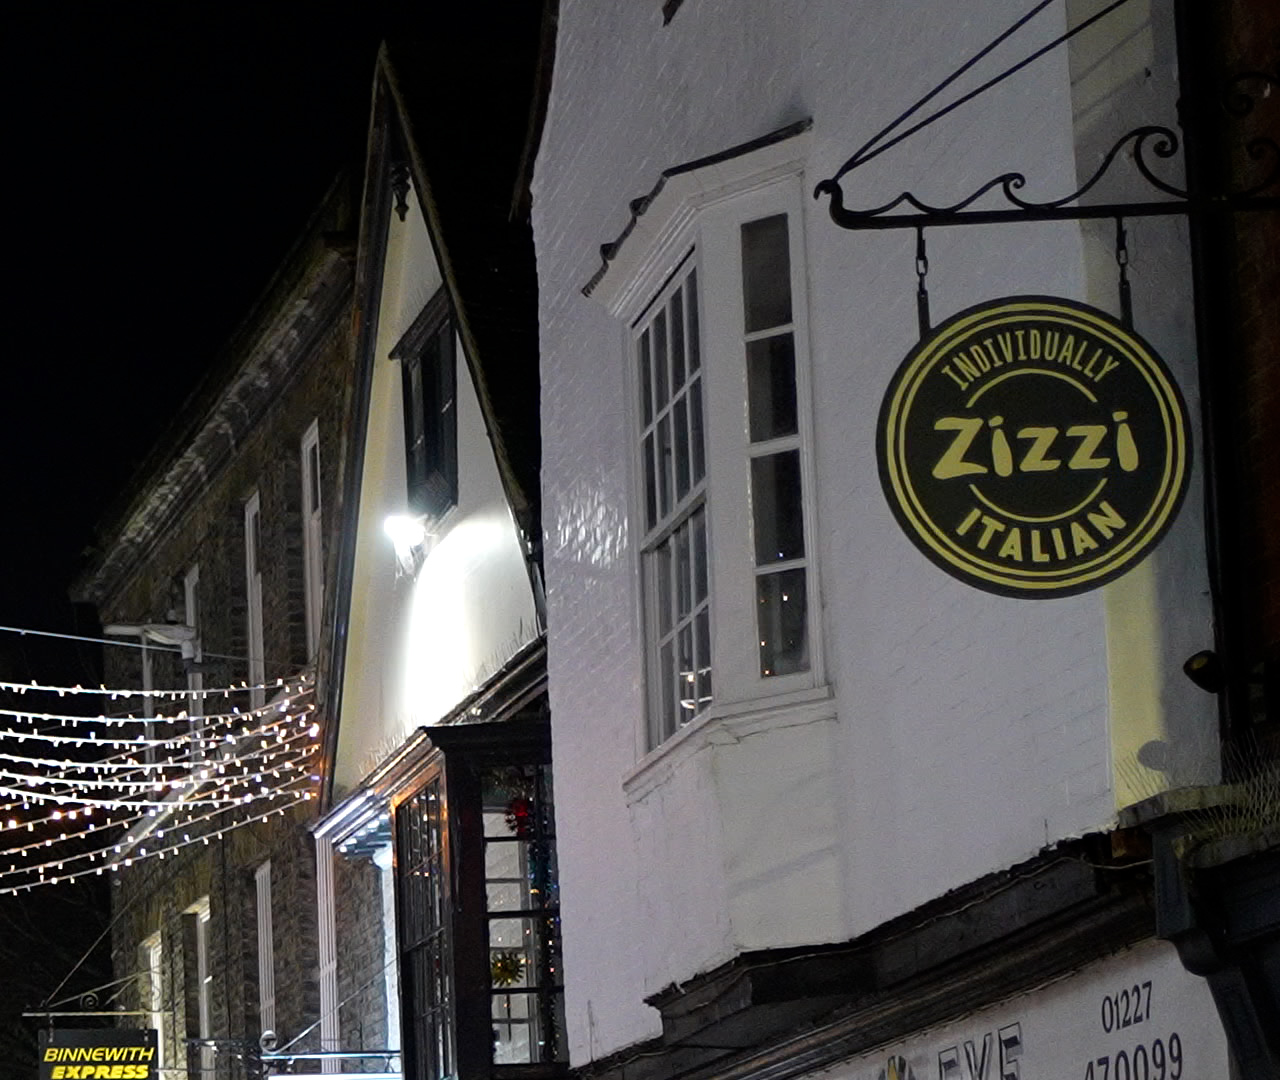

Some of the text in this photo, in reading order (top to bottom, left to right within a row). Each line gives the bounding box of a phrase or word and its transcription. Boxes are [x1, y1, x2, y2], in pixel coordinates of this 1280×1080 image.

[941, 329, 1120, 391] INDIVIDUALLY
[932, 411, 1139, 480] Zizzi
[956, 501, 1127, 563] ITALIAN
[1100, 980, 1153, 1034] 01227
[43, 1047, 155, 1062] BINNEWITH
[51, 1065, 149, 1080] EXPRESS
